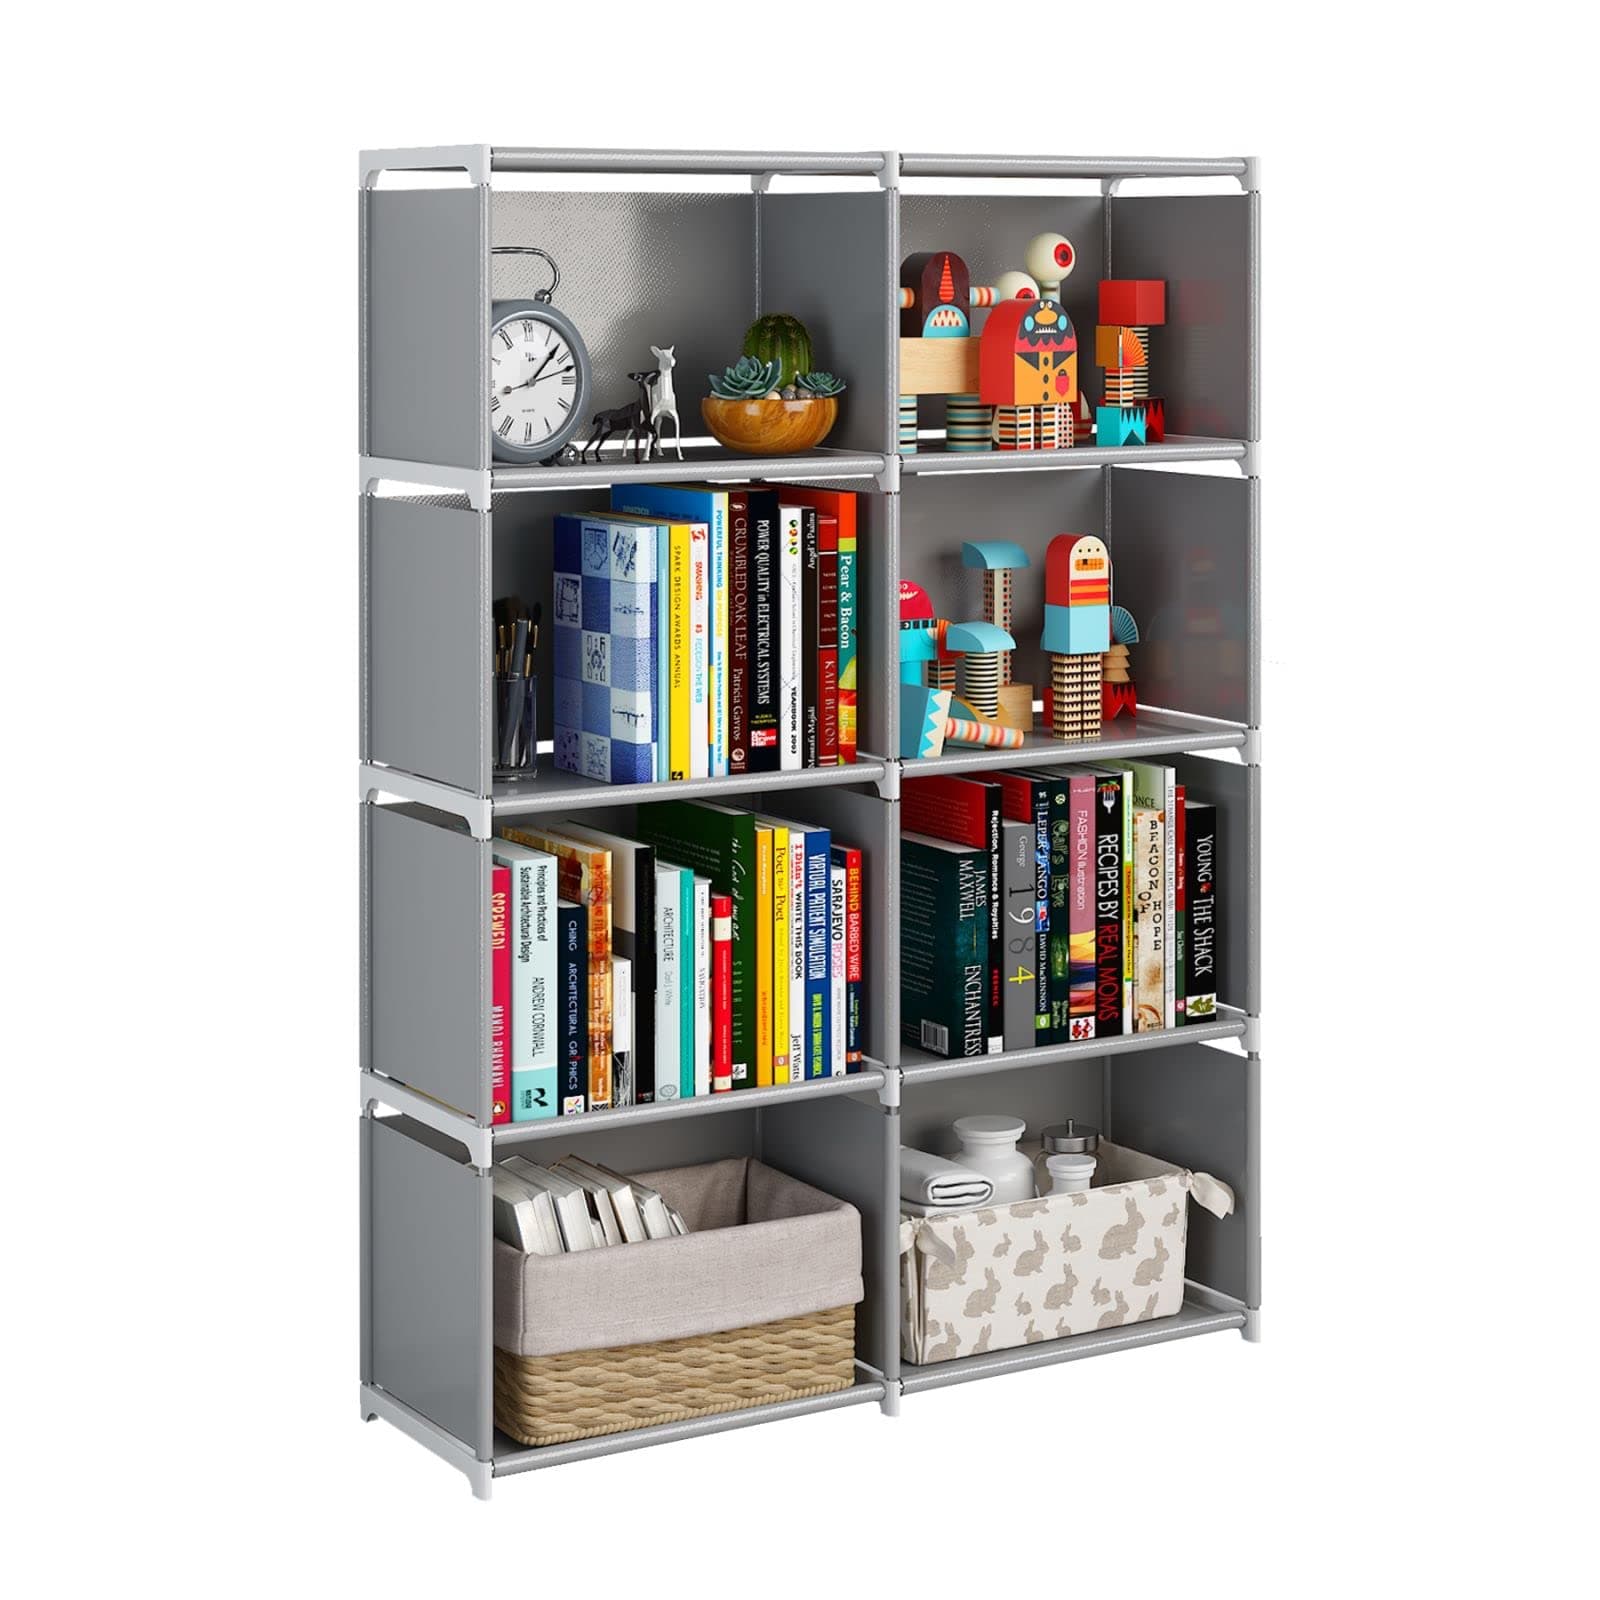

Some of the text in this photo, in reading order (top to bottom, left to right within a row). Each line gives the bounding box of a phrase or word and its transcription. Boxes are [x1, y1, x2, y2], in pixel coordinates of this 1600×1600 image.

[756, 520, 770, 551] POWER
[695, 561, 703, 600] SMASHING
[735, 517, 747, 660] CRUMBLED OAK LEAF
[754, 552, 770, 594] QUALITY
[673, 545, 682, 688] SPARK DESIGN AWARDS ANNUAL
[840, 555, 852, 649] Pear & Bacon
[756, 603, 770, 661] ELECTRICAL
[732, 668, 744, 704] Patricia
[756, 662, 770, 704] SYSTEMS
[991, 809, 999, 852] Rejection,
[1037, 811, 1049, 850] LEPER
[1077, 809, 1089, 861] FASHION
[776, 847, 787, 875] Poet
[794, 852, 803, 889] Didn't
[1016, 835, 1029, 868] George
[536, 865, 548, 893] Principles
[808, 853, 827, 892] VIRTUAL
[849, 867, 860, 911] BEHIND
[959, 860, 987, 922] JAMES MAXWELL
[991, 853, 999, 892] Romance
[517, 867, 532, 963] Sustainable Architectural Design
[536, 895, 548, 905] and
[536, 906, 548, 933] Practices
[776, 894, 787, 922] Poet
[794, 891, 803, 923] WRITE
[808, 892, 827, 927] PATIENT
[832, 879, 843, 941] SARAJEVO
[991, 901, 999, 940] Royalties
[1193, 834, 1215, 978] YOUNG THE SHACK
[568, 920, 578, 952] CHING
[663, 907, 675, 963] ARCHITECTURE
[794, 925, 803, 949] THIS
[849, 912, 860, 953] BARBED
[1097, 834, 1119, 1021] RECIPES BY REAL MOMS
[794, 950, 803, 980] BOOK
[808, 928, 827, 981] SIMULATION
[849, 953, 860, 981] WIRE
[1039, 934, 1048, 1012] DAVID MacKINNON
[532, 977, 545, 1057] ANDREW CORNWALL
[568, 962, 578, 1037] ARCHITECTURAL
[964, 964, 982, 1057] ENCHANTRESS
[791, 1033, 802, 1081] Jeff Watts
